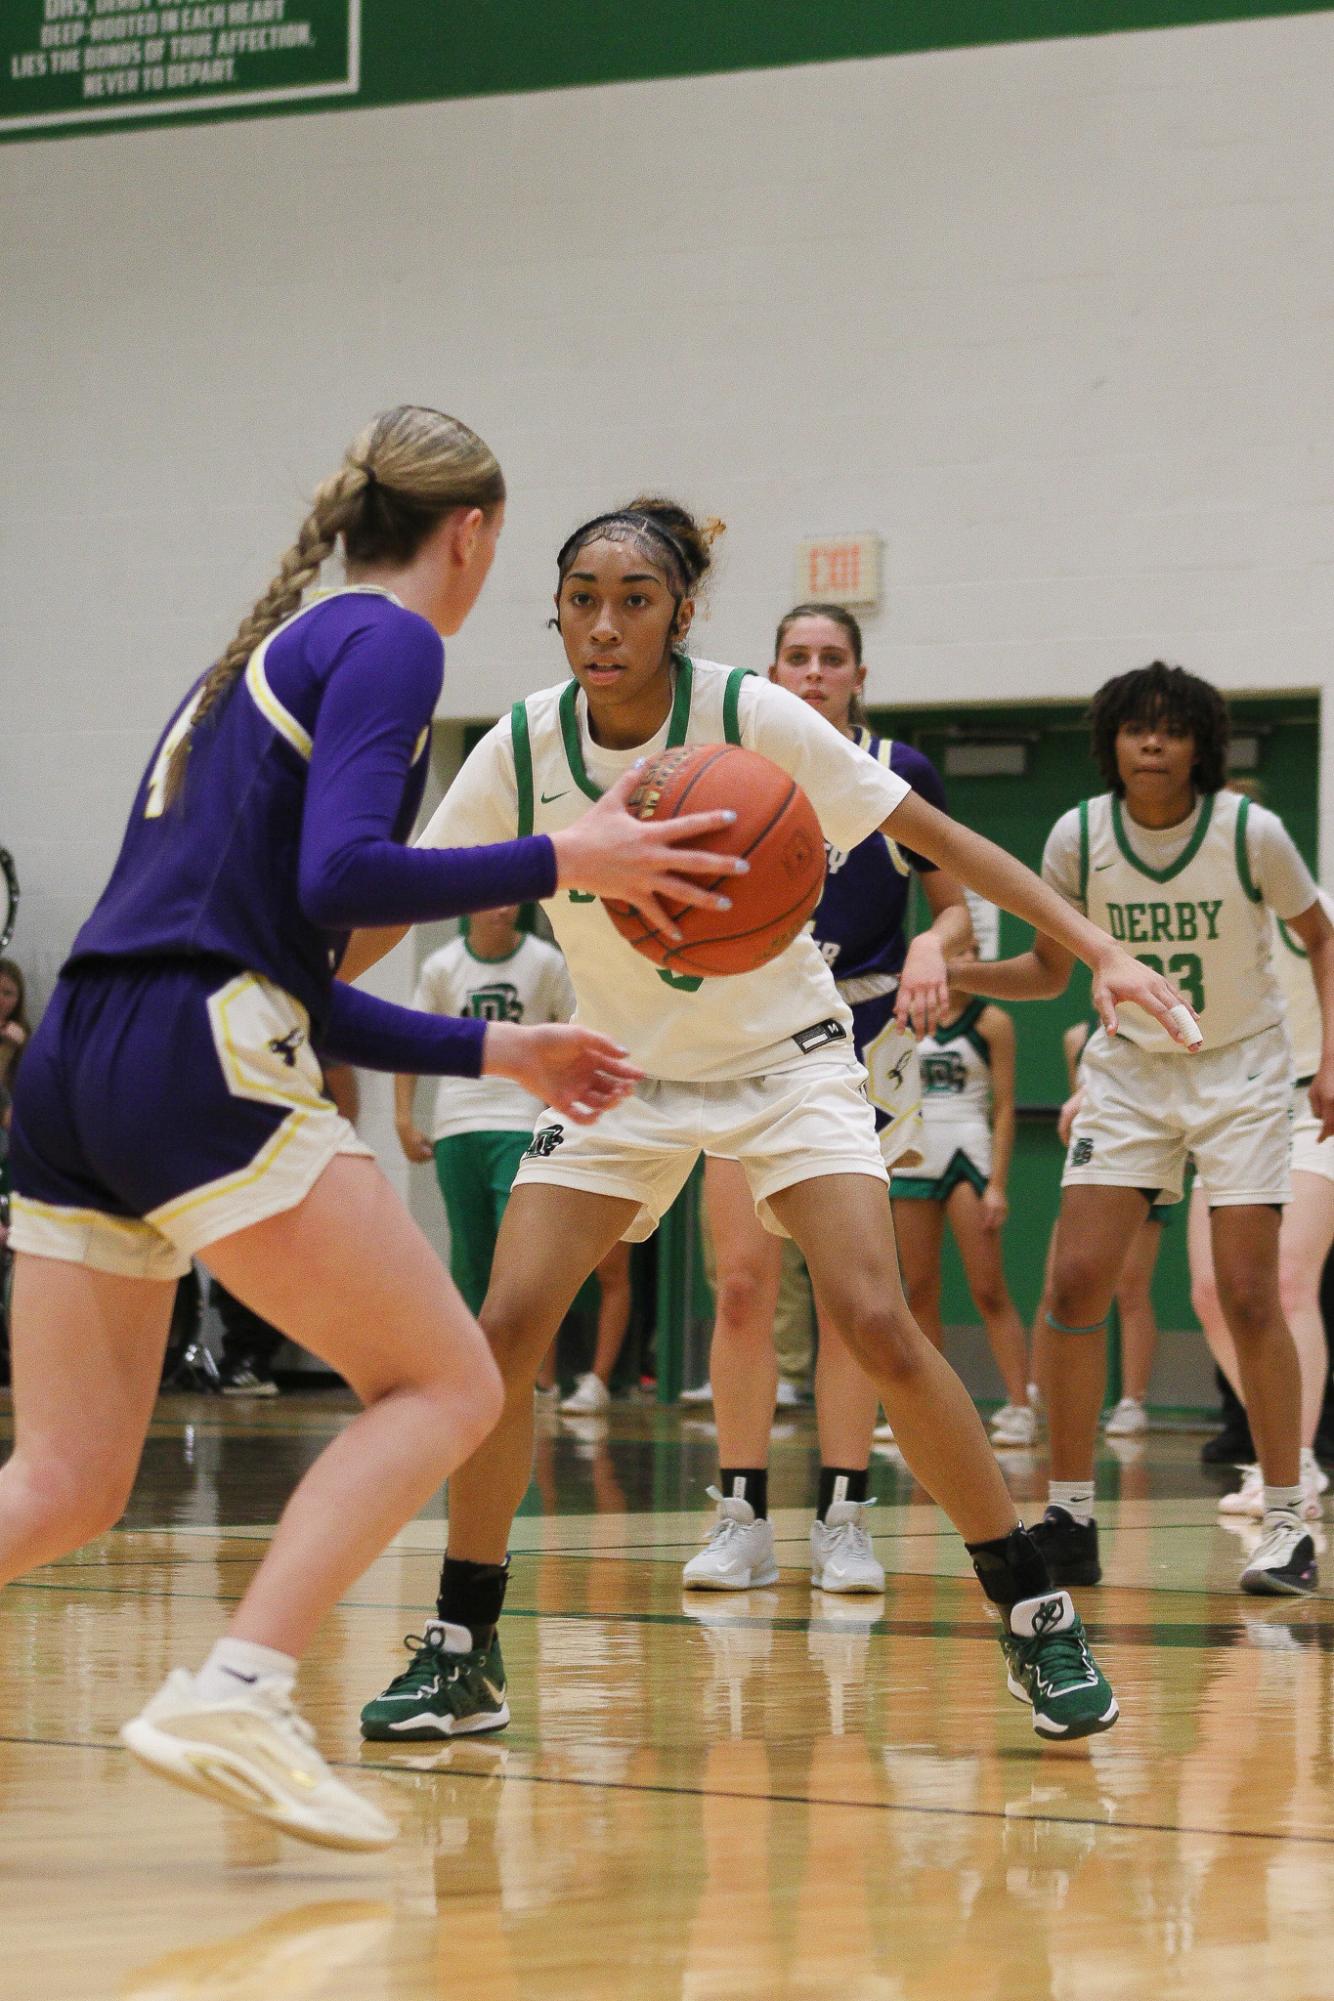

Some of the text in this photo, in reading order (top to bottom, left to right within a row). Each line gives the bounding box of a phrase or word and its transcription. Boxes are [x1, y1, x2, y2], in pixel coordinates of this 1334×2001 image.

[11, 53, 47, 79] LIES
[50, 49, 80, 73] THE
[145, 39, 165, 64] OF
[170, 33, 213, 59] TRUE
[83, 69, 139, 97] NEVER
[143, 65, 164, 91] TO
[1105, 900, 1224, 943] DERBY
[1135, 953, 1206, 1015] 3
